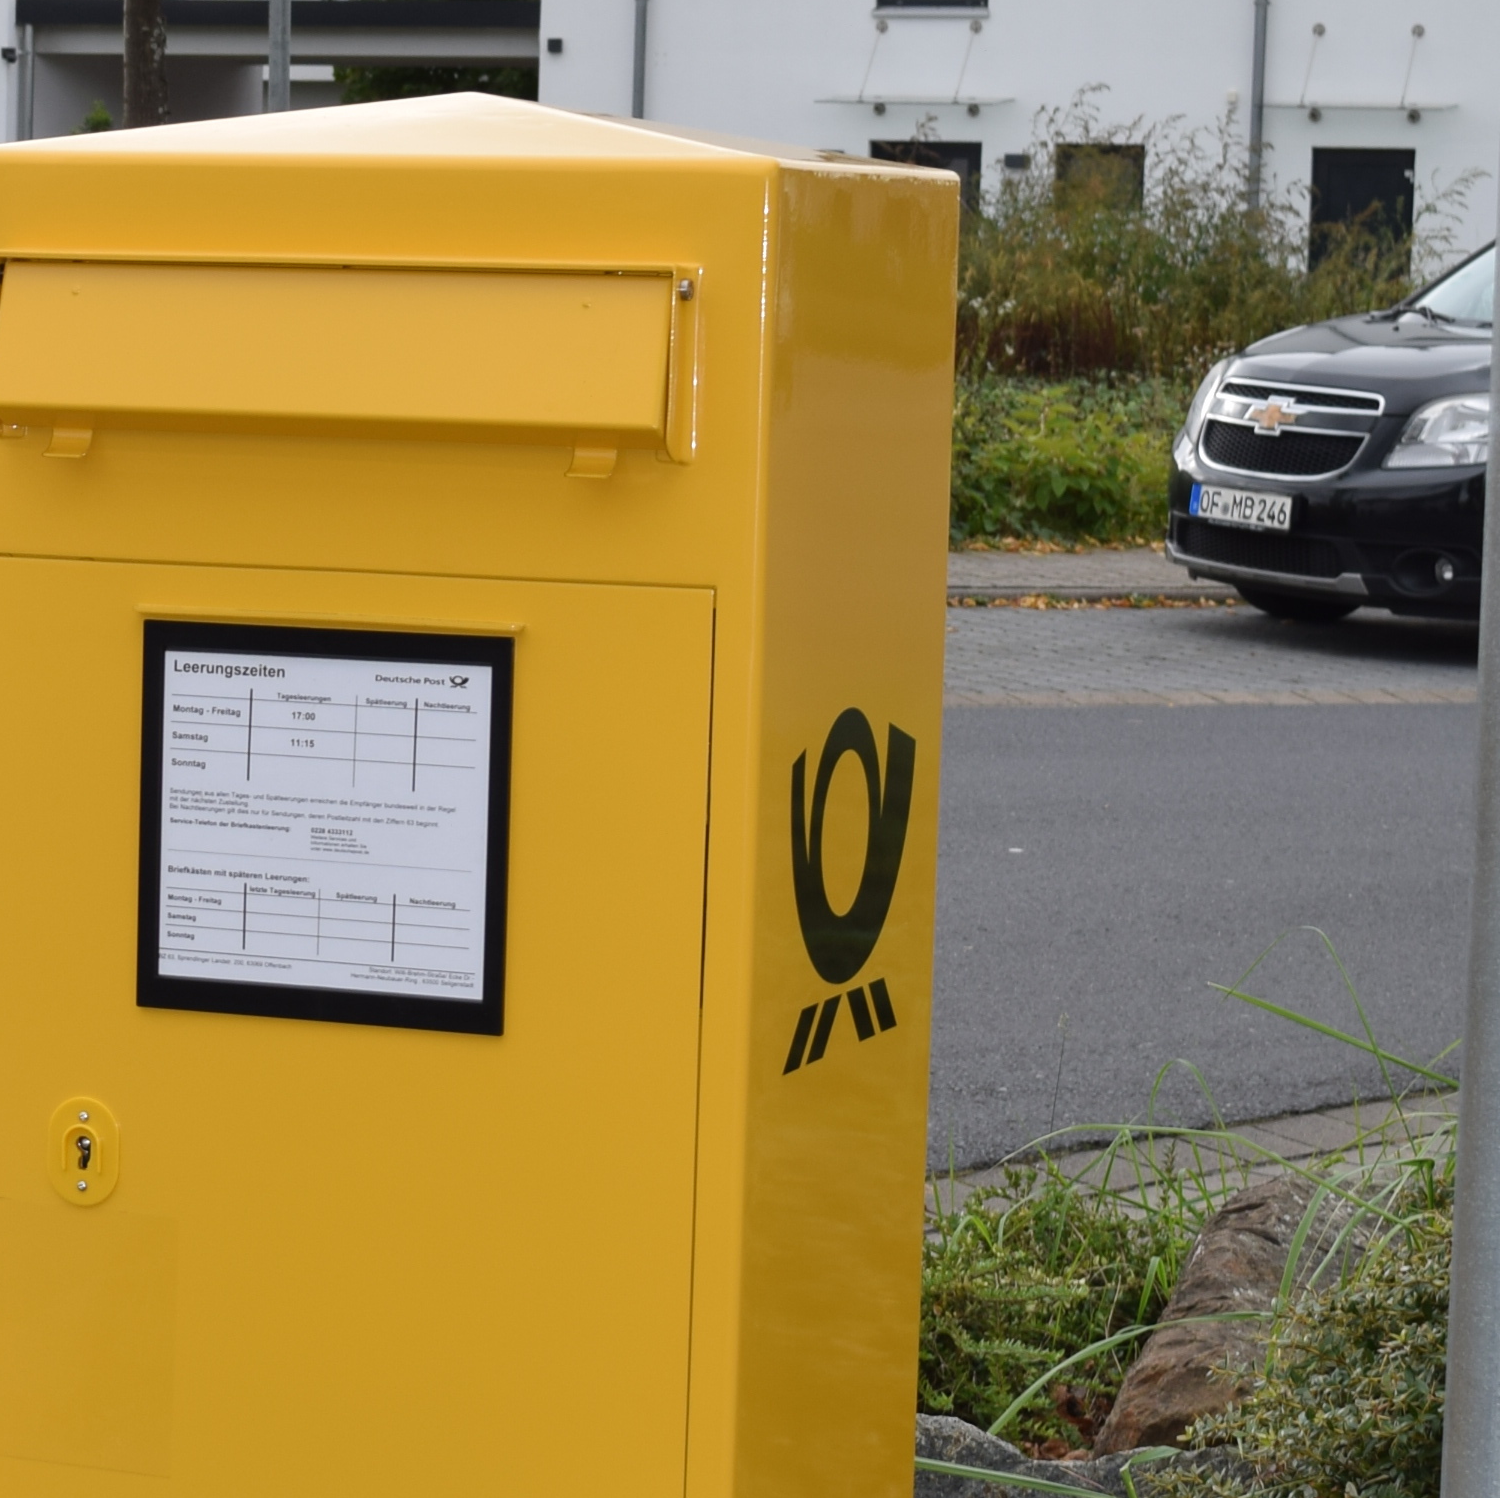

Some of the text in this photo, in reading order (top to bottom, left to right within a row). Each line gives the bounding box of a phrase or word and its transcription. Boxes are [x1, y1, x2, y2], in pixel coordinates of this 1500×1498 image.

[1200, 490, 1222, 514] OF
[1231, 494, 1254, 520] MB
[1256, 499, 1287, 525] 246
[174, 659, 286, 678] Leerungszeiten
[375, 674, 446, 686] Deutsche Post
[277, 692, 332, 703] Tagesleerungen
[366, 698, 408, 709] Spätleerung
[172, 704, 204, 716] Montag
[211, 707, 242, 718] Freitag
[423, 701, 471, 713] Nachtleerung
[291, 711, 316, 721] 17:00
[172, 731, 209, 743] Samstag
[290, 738, 315, 748] 11:15
[171, 758, 206, 770] Sonntag
[168, 865, 310, 884] Briefkästen mit späteren Leerungen:
[249, 886, 316, 899] letzte Tagesleerung
[336, 892, 378, 903] Spätleerung
[167, 894, 193, 903] Montag
[198, 896, 222, 906] Freitag
[409, 898, 456, 910] Nachtleerung
[167, 912, 197, 922] Samstag
[167, 931, 195, 941] Sonntag
